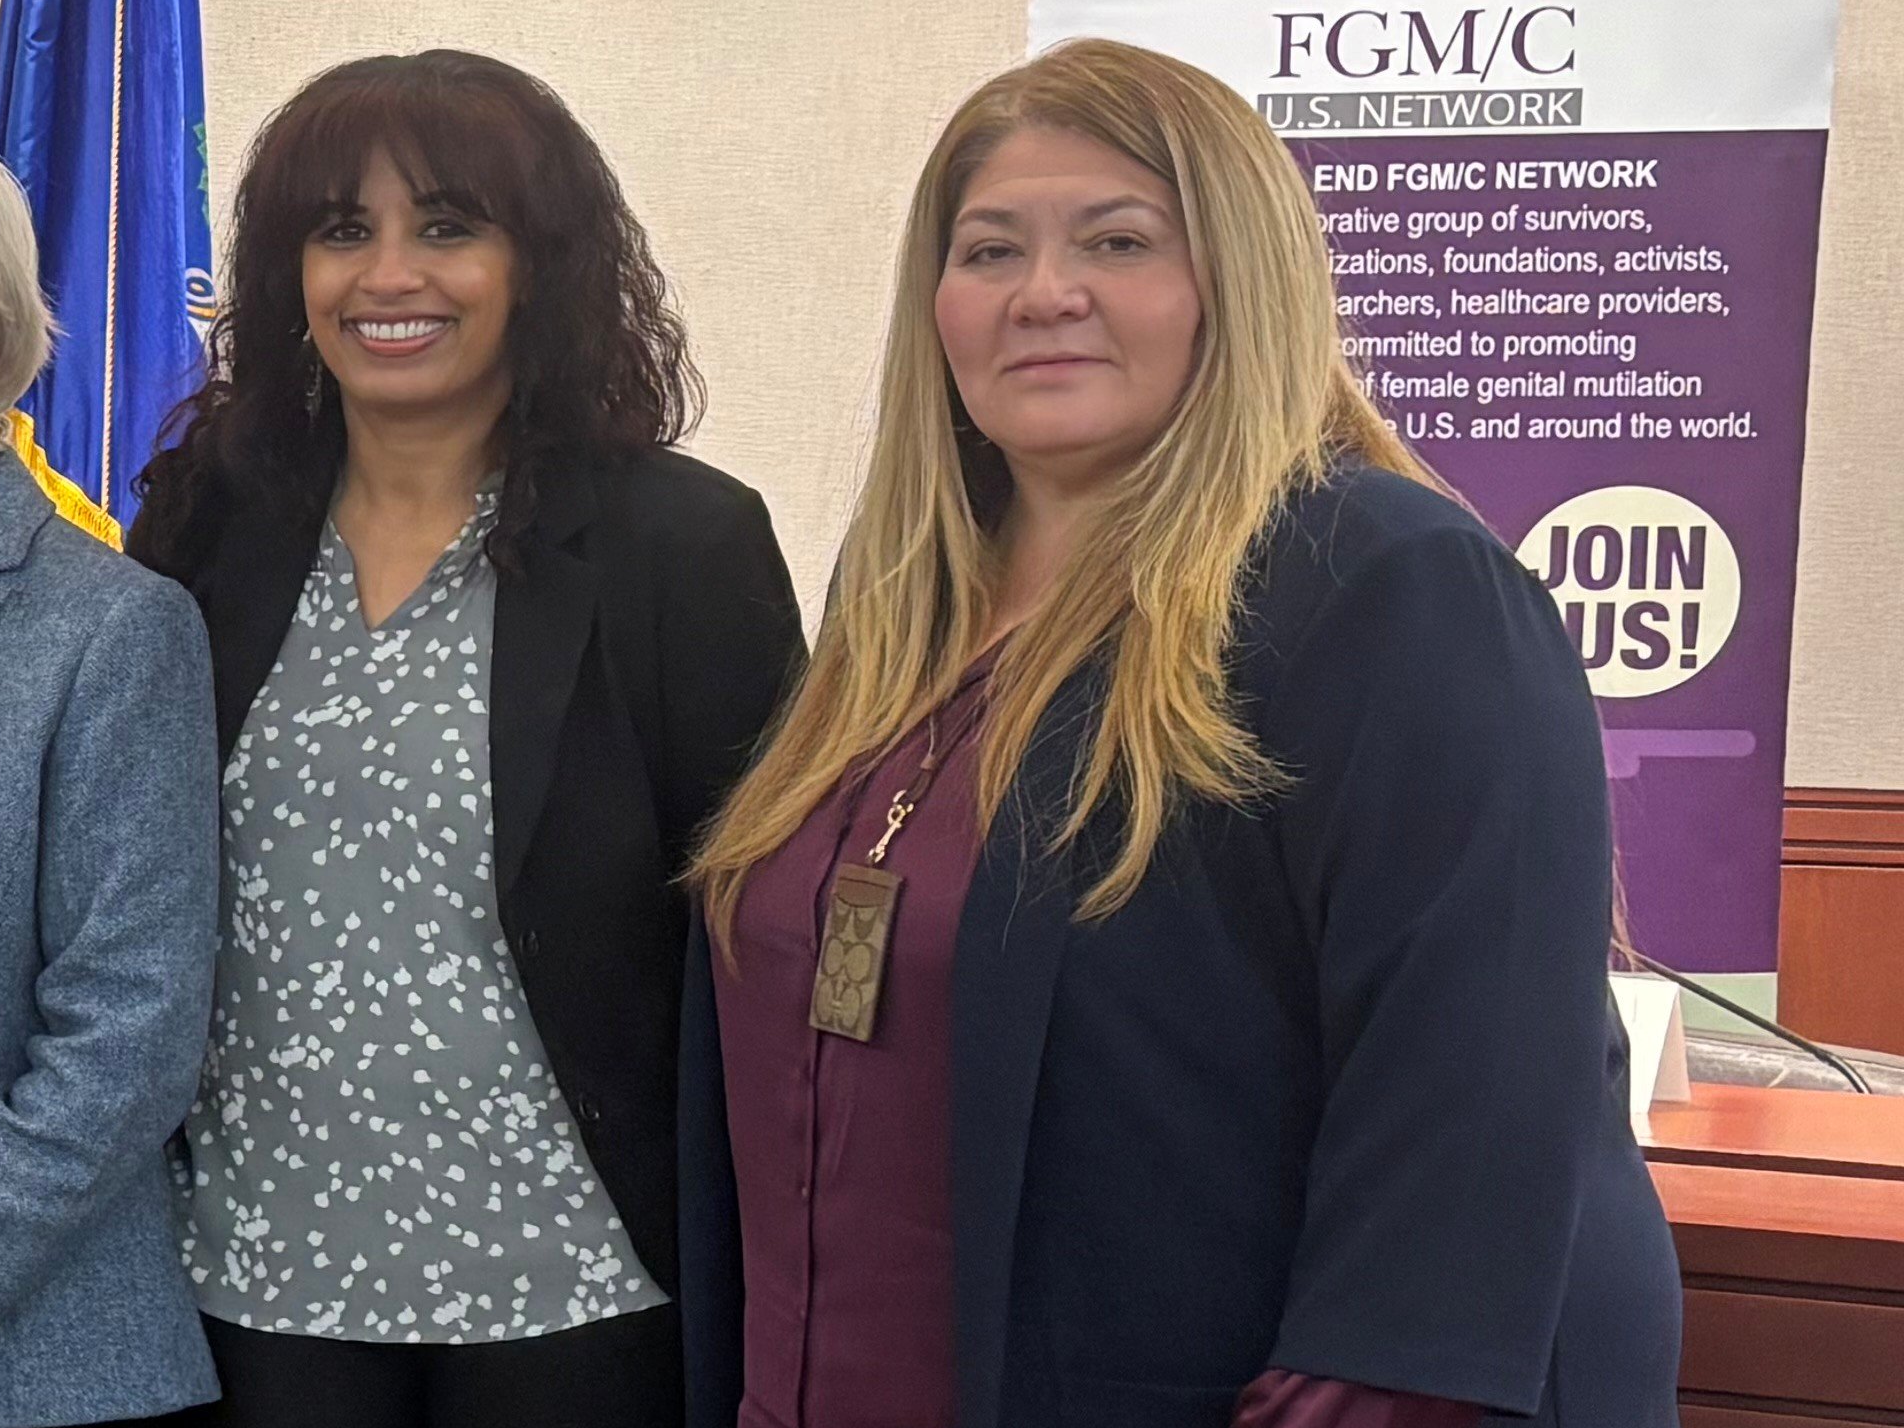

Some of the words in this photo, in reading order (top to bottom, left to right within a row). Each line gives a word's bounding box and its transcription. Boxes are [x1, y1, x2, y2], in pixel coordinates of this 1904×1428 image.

[1269, 5, 1576, 83] FGM/C
[1265, 95, 1342, 129] U.S.
[1358, 91, 1574, 127] NETWORK
[1314, 164, 1379, 192] END
[1387, 161, 1486, 191] FGM/C
[1495, 159, 1658, 190] NETWORK
[1407, 209, 1484, 239] group
[1491, 203, 1520, 232] of
[1524, 203, 1653, 234] survivors,
[1443, 245, 1605, 276] foundations,
[1613, 244, 1730, 274] activists,
[1450, 288, 1591, 315] healthcare
[1597, 286, 1730, 320] providers,
[1337, 329, 1462, 357] ommitted
[1470, 330, 1495, 357] to
[1503, 329, 1637, 362] promoting
[1381, 370, 1470, 398] female
[1477, 370, 1565, 404] genital
[1572, 370, 1702, 398] mutilation
[1406, 412, 1462, 440] U.S.
[1470, 412, 1520, 439] and
[1527, 411, 1622, 439] around
[1630, 411, 1673, 439] the
[1679, 411, 1758, 439] world.
[1532, 524, 1707, 591] JOIN
